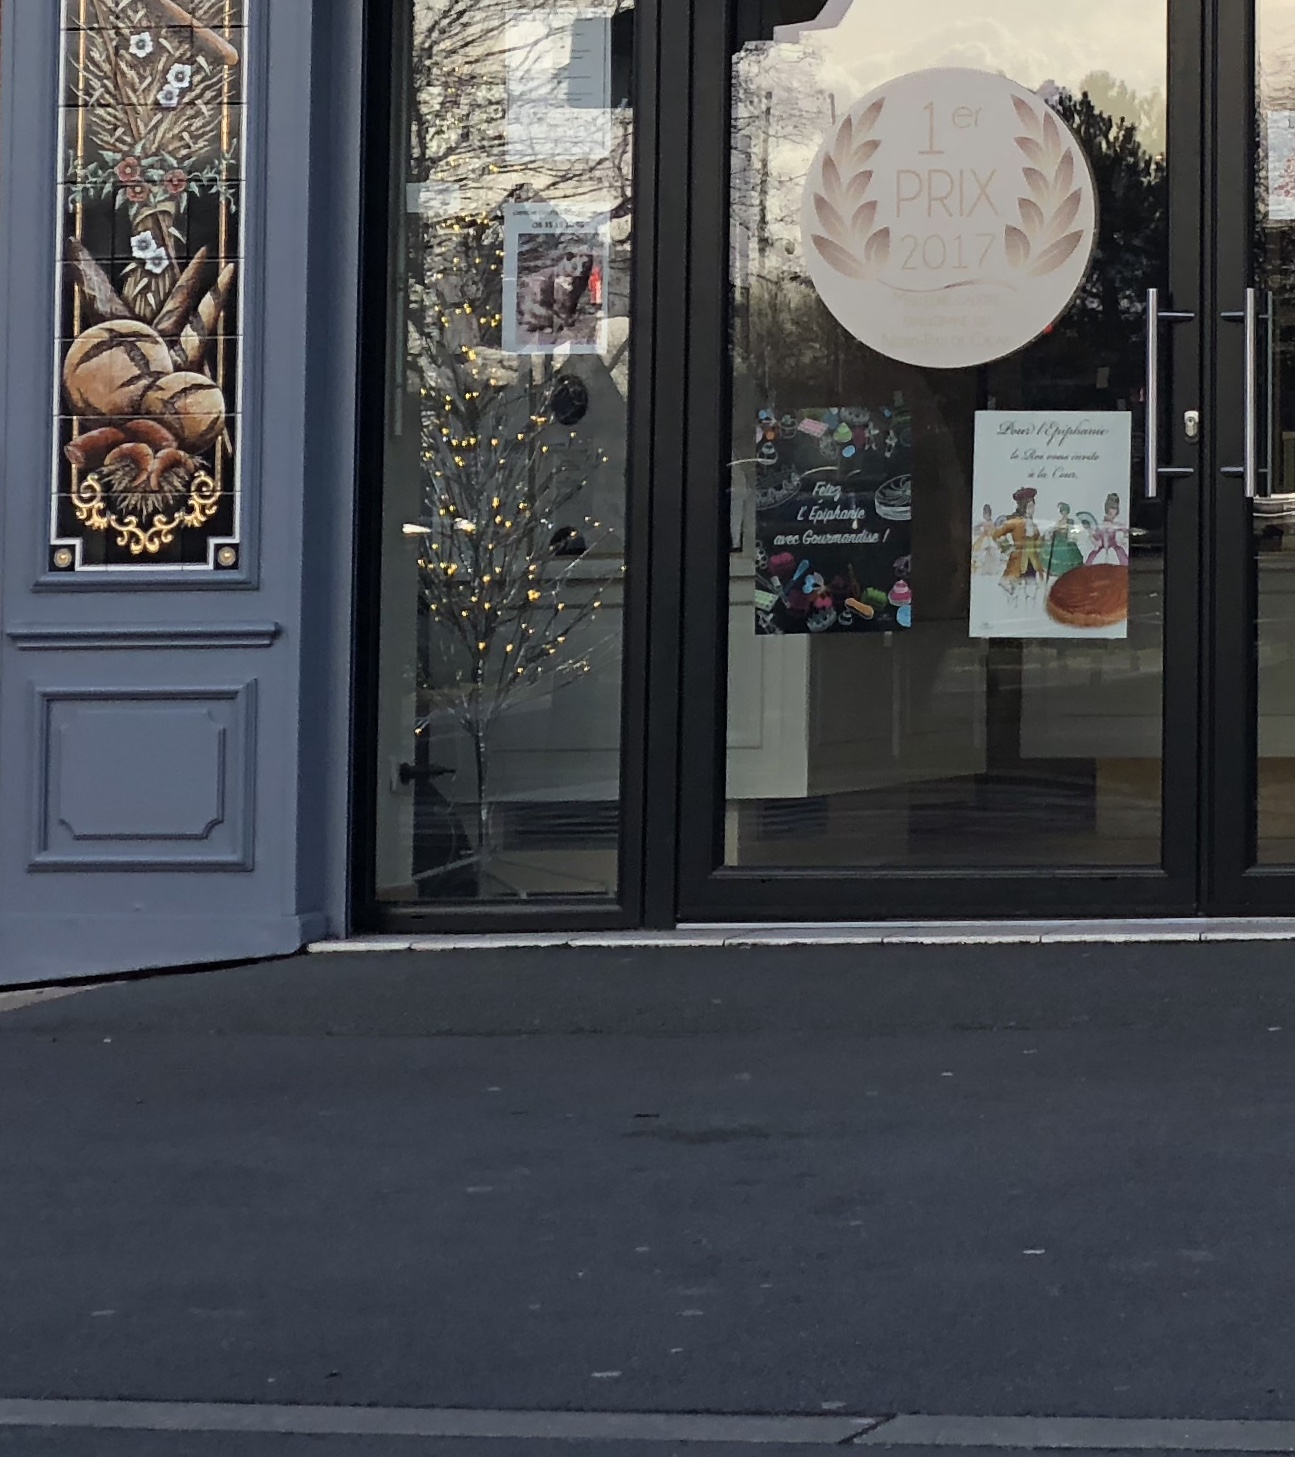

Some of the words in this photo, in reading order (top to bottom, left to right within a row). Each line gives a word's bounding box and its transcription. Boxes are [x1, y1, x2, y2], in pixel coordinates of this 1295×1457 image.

[895, 168, 1000, 218] PRIX
[900, 233, 997, 270] 2017
[773, 534, 800, 545] avec
[802, 529, 879, 545] Gourmandise
